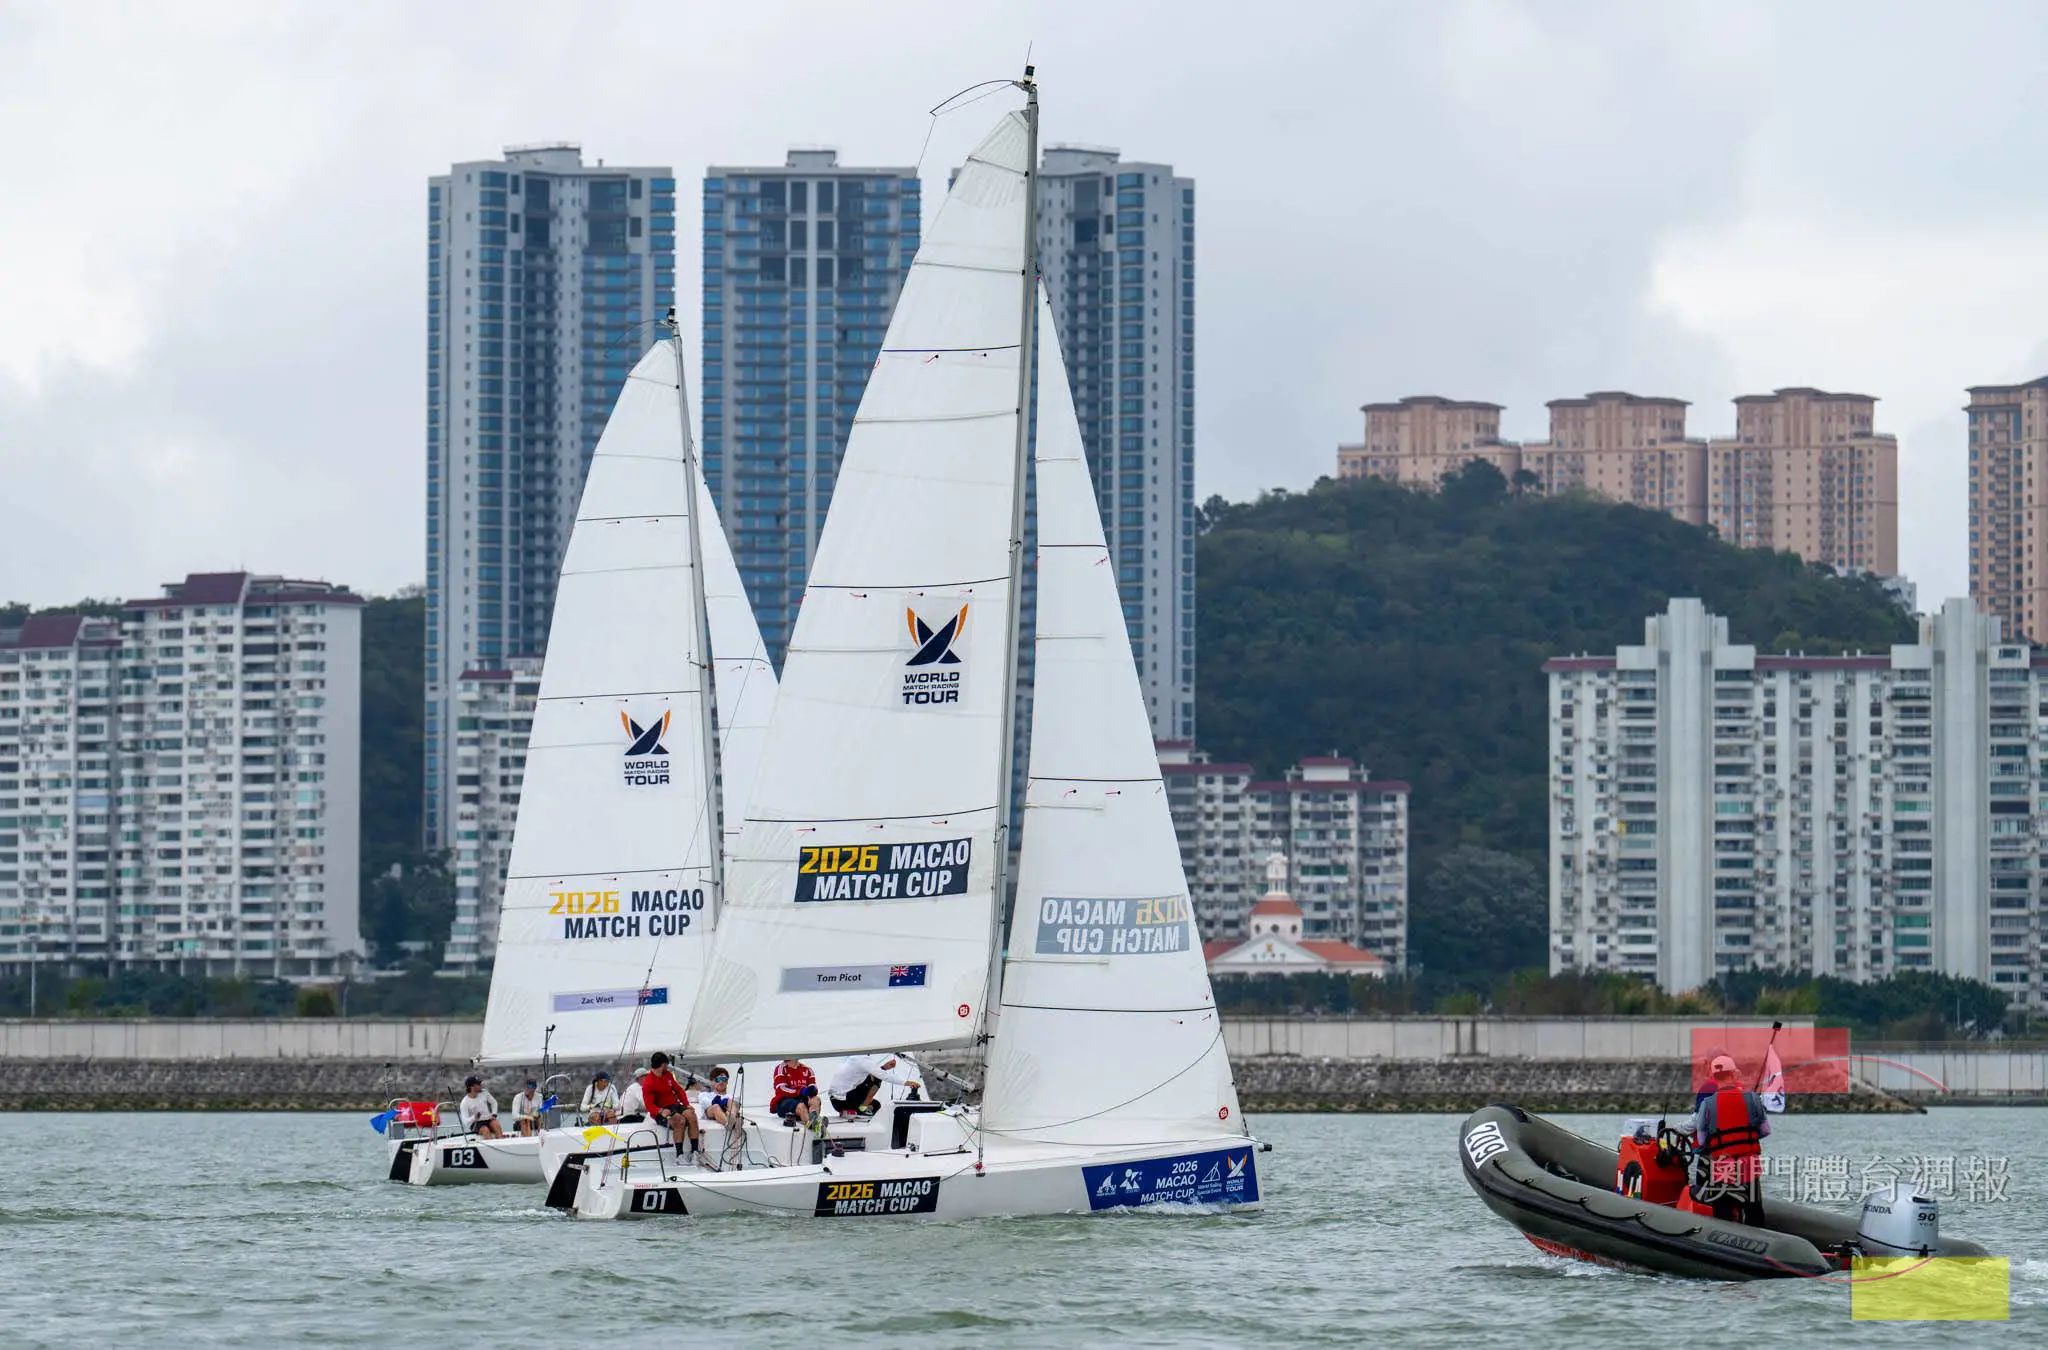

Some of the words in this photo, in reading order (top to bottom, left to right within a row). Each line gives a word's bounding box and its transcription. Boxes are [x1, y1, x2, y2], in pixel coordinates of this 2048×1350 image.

[904, 672, 960, 684] WORLD
[902, 690, 959, 704] TOUR
[624, 760, 669, 769] WORLD
[624, 775, 670, 785] TOUR
[800, 846, 879, 874] 2026
[889, 840, 969, 870] MACAO
[813, 873, 899, 900] MATCH
[905, 870, 952, 896] CUP
[548, 891, 620, 915] 2026
[631, 888, 704, 912] MACAO
[564, 915, 641, 939] MATCH
[649, 914, 691, 936] CUP
[817, 974, 837, 983] Tom
[839, 973, 862, 982] Picot
[581, 997, 594, 1005] Zac
[595, 996, 614, 1004] West
[1467, 1124, 1505, 1163] 209
[451, 1149, 475, 1166] 03
[1171, 1160, 1198, 1175] 2026
[826, 1183, 875, 1200] 2026
[880, 1180, 931, 1198] MACAO
[1155, 1174, 1197, 1190] MACAO
[642, 1190, 668, 1210] 01
[1140, 1190, 1173, 1203] MATCH
[1175, 1187, 1195, 1199] CUP
[834, 1199, 886, 1214] MATCH
[889, 1197, 919, 1213] CUP
[1863, 1204, 1892, 1215] HONDA
[1917, 1212, 1936, 1222] 90
